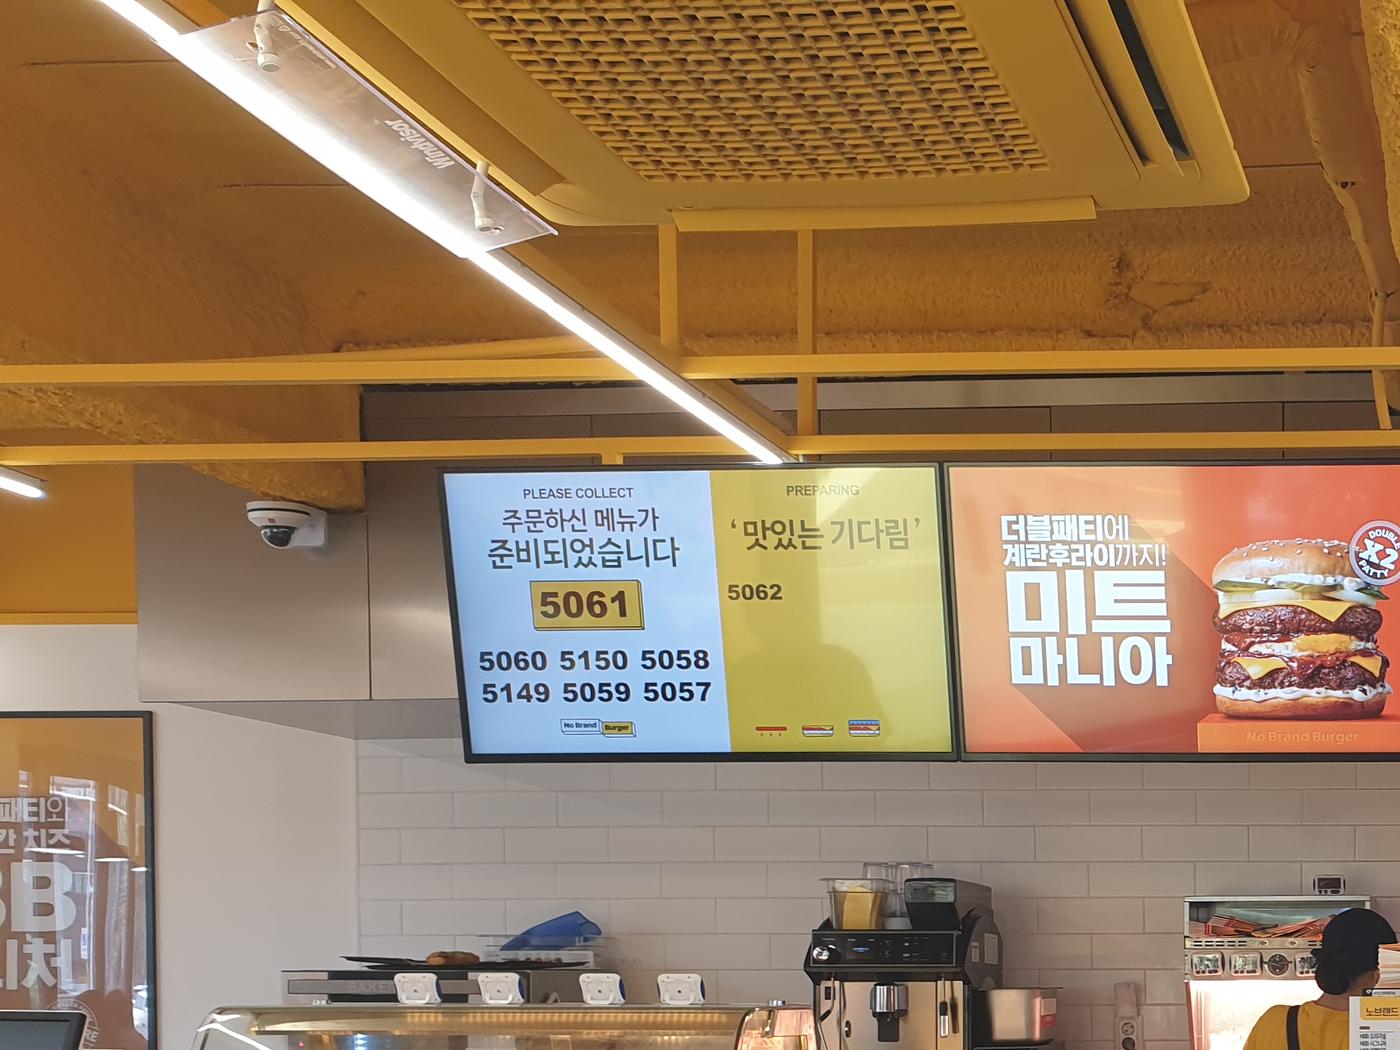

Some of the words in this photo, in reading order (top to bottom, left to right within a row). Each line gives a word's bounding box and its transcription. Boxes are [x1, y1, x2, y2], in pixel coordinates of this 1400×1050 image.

[523, 488, 573, 499] PLEASE
[575, 486, 634, 499] COLLECT
[786, 485, 860, 497] PREPARING
[502, 508, 588, 534] 주문하신
[594, 507, 660, 532] 메뉴가
[1000, 515, 1129, 542] 더블패티에
[487, 537, 680, 569] 준비되었습니다
[1002, 543, 1168, 568] 계란후라이까지!
[1358, 559, 1389, 578] PATTY
[727, 583, 783, 601] 5062
[1005, 569, 1172, 635] 미트
[540, 590, 629, 619] 5061
[479, 650, 547, 672] 5060
[559, 650, 629, 671] 5150
[641, 649, 710, 670] 5058
[1009, 635, 1174, 688] 마니아
[482, 683, 551, 703] 5149
[562, 682, 631, 703] 5059
[643, 681, 712, 702] 5057
[563, 721, 574, 730] No
[575, 720, 597, 730] Brand
[604, 723, 630, 734] Burger
[1246, 730, 1265, 743] No
[1268, 730, 1309, 743] Brand
[1312, 730, 1359, 745] Burger
[1365, 1008, 1399, 1017] 노브랜드
